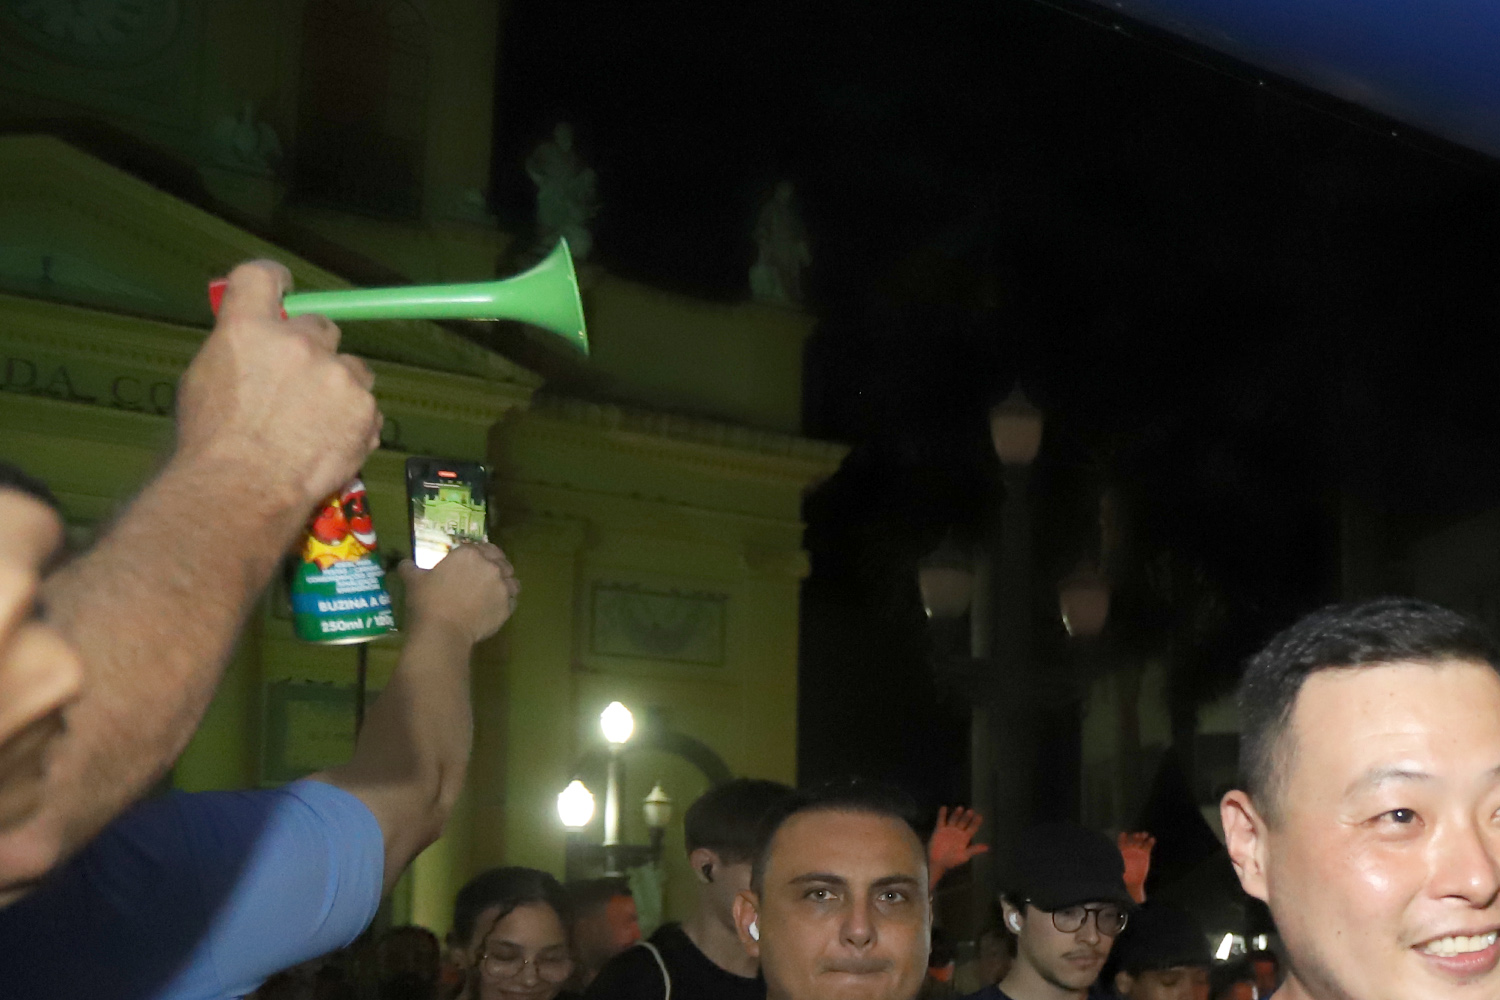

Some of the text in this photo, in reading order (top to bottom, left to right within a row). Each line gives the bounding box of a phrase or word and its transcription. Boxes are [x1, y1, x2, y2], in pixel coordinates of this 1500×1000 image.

[318, 597, 369, 612] BUZINA
[370, 596, 379, 607] A
[321, 618, 364, 632] 250ml
